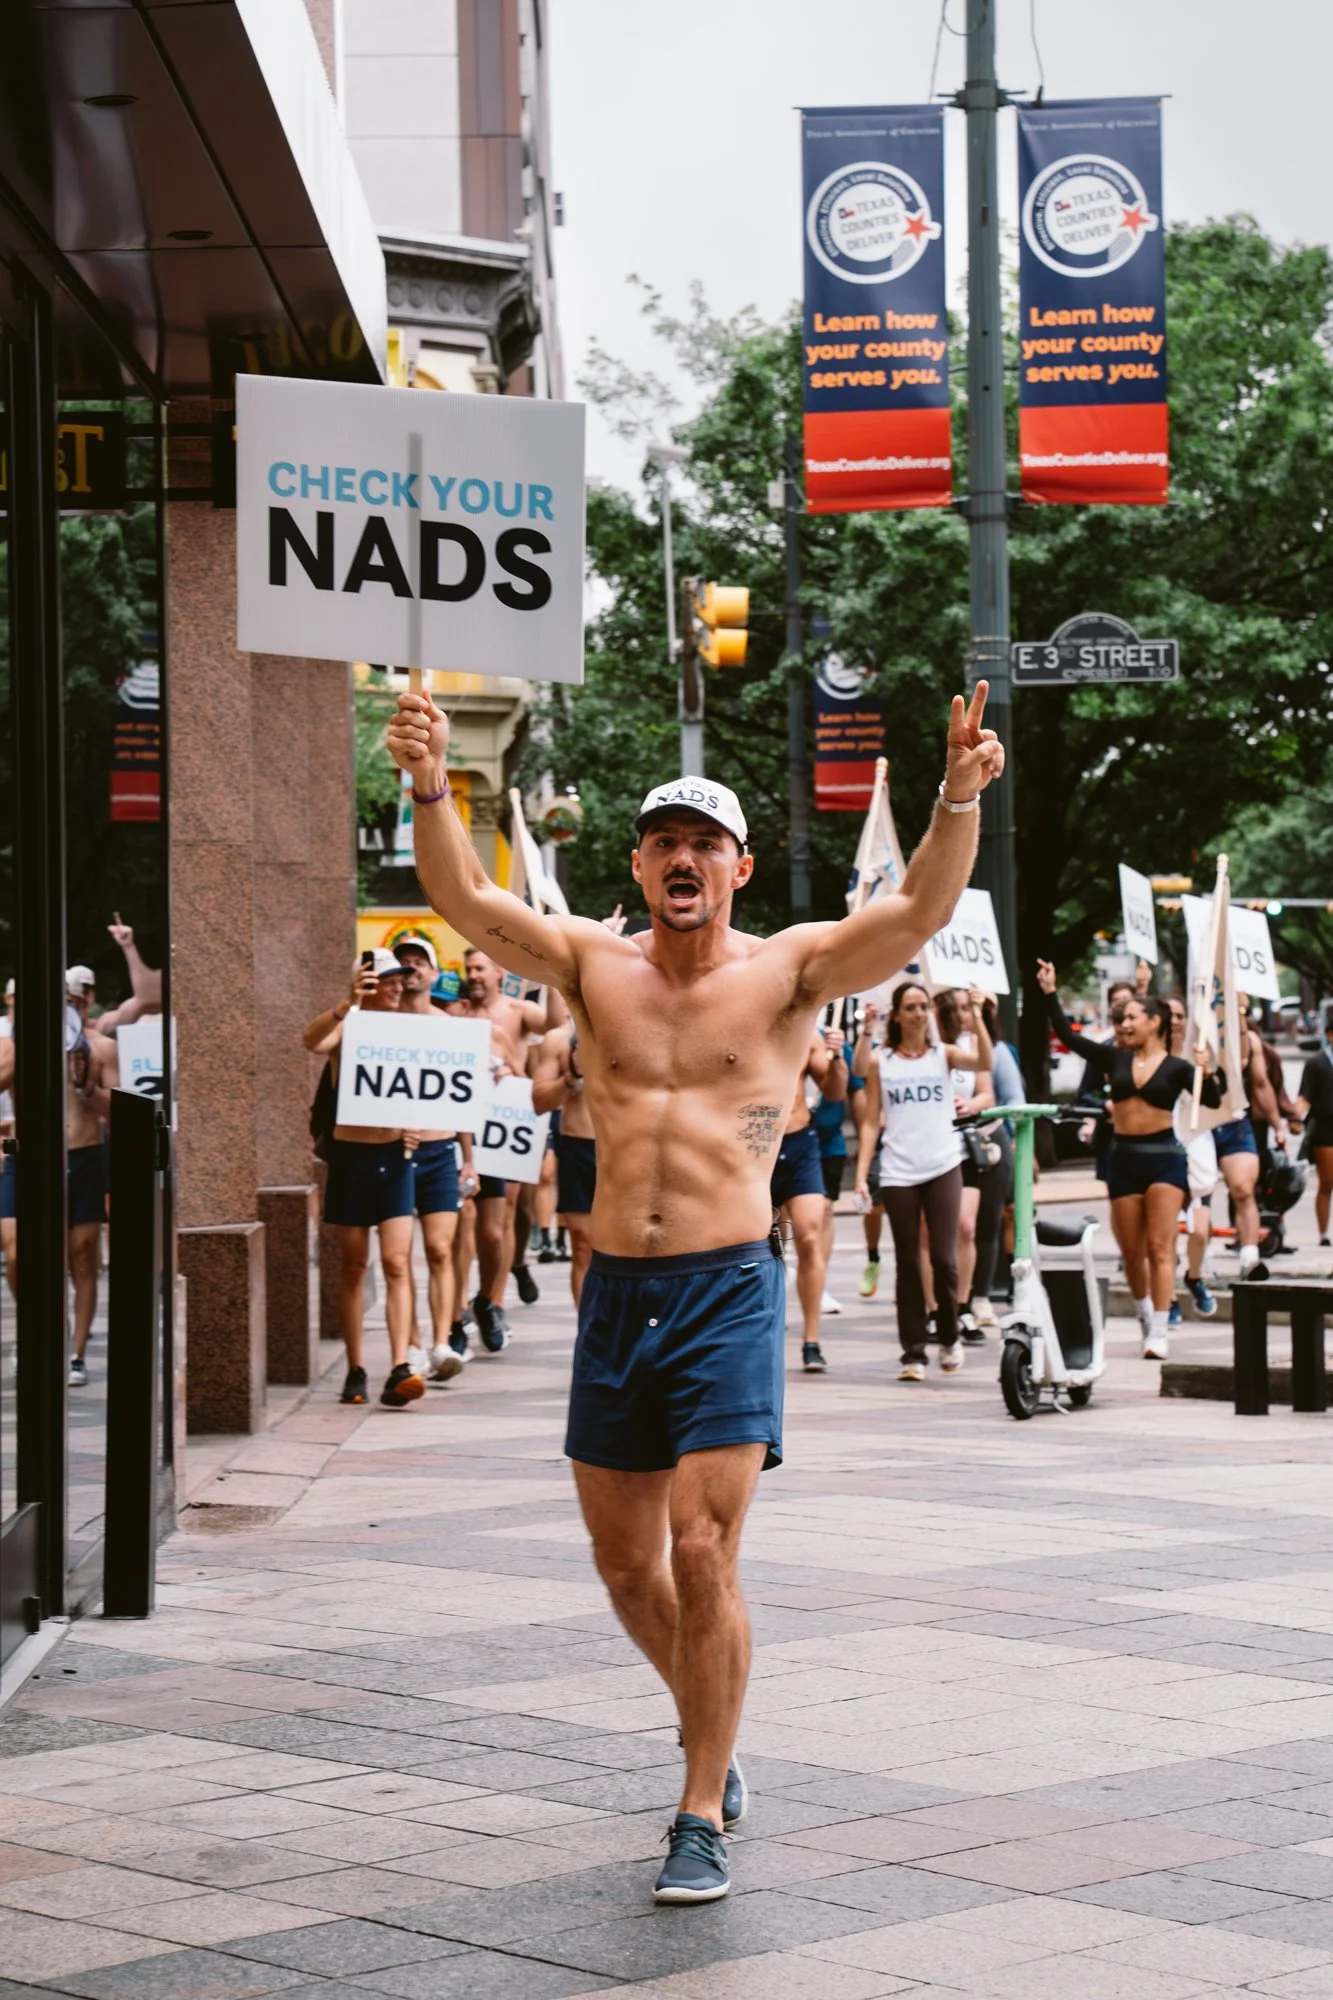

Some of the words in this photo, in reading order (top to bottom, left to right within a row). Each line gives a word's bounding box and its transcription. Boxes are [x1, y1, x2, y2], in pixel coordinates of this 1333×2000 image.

[856, 196, 896, 214] TEXAS
[1072, 188, 1112, 207] TEXAS
[841, 212, 901, 234] COUNTIES
[1056, 205, 1117, 228] COUNTIES
[847, 231, 895, 251] DELIVER
[1063, 224, 1112, 244] DELIVER
[814, 313, 880, 332] Learn
[885, 310, 937, 329] how
[1030, 307, 1097, 327] Learn
[1102, 304, 1155, 324] how
[805, 344, 860, 366] your
[864, 338, 946, 361] county
[1021, 338, 1076, 360] your
[1081, 332, 1164, 355] county
[810, 370, 887, 388] serves
[890, 368, 942, 390] you.
[1026, 364, 1104, 383] serves
[1107, 363, 1159, 385] you.
[267, 461, 418, 508] CHECK
[429, 475, 554, 521] YOUR
[268, 506, 552, 611] NADS
[1079, 644, 1170, 668] STREET
[656, 789, 719, 809] NADS
[932, 931, 994, 966] NADS
[1236, 947, 1267, 975] DS
[355, 1044, 420, 1064] CHECK
[424, 1048, 477, 1067] YOUR
[354, 1063, 473, 1103] NADS
[886, 1085, 944, 1107] NADS
[474, 1120, 533, 1155] DS
